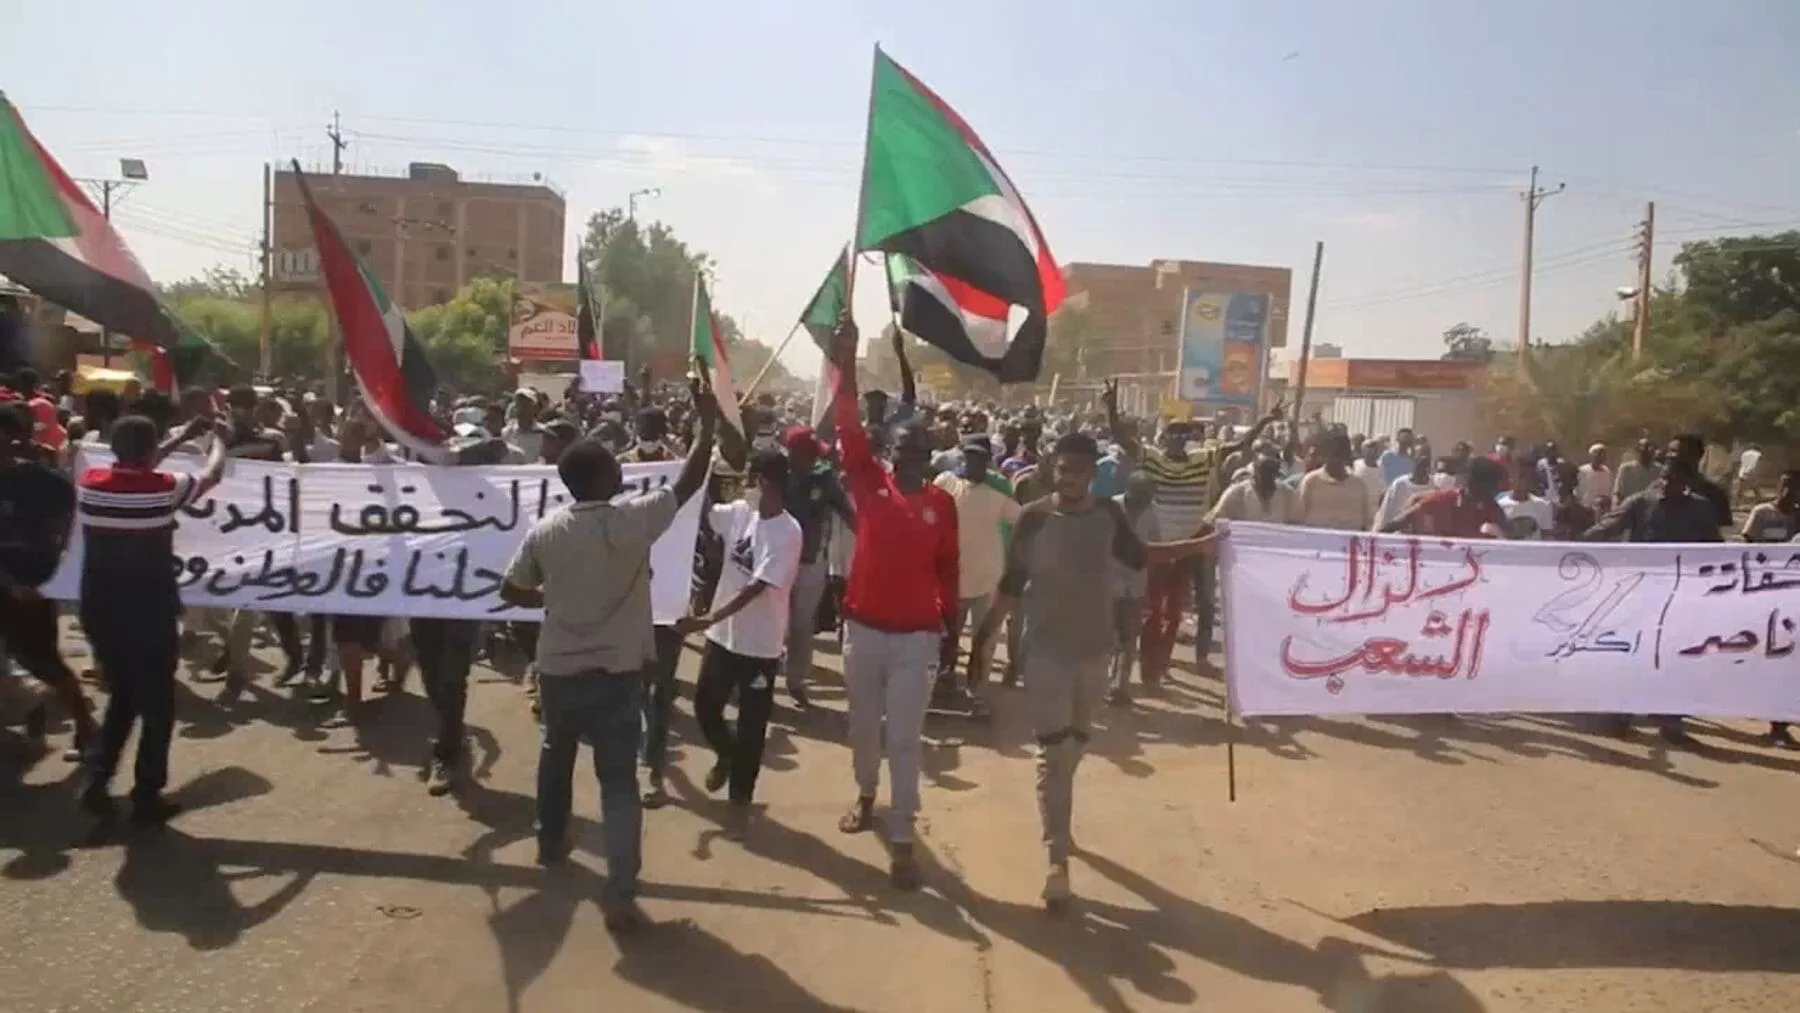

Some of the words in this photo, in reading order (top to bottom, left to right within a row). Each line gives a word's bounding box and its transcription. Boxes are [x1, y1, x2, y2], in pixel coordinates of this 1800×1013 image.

[520, 319, 553, 339] العم
[557, 319, 577, 334] لاد
[1280, 607, 1490, 695] الشعب
